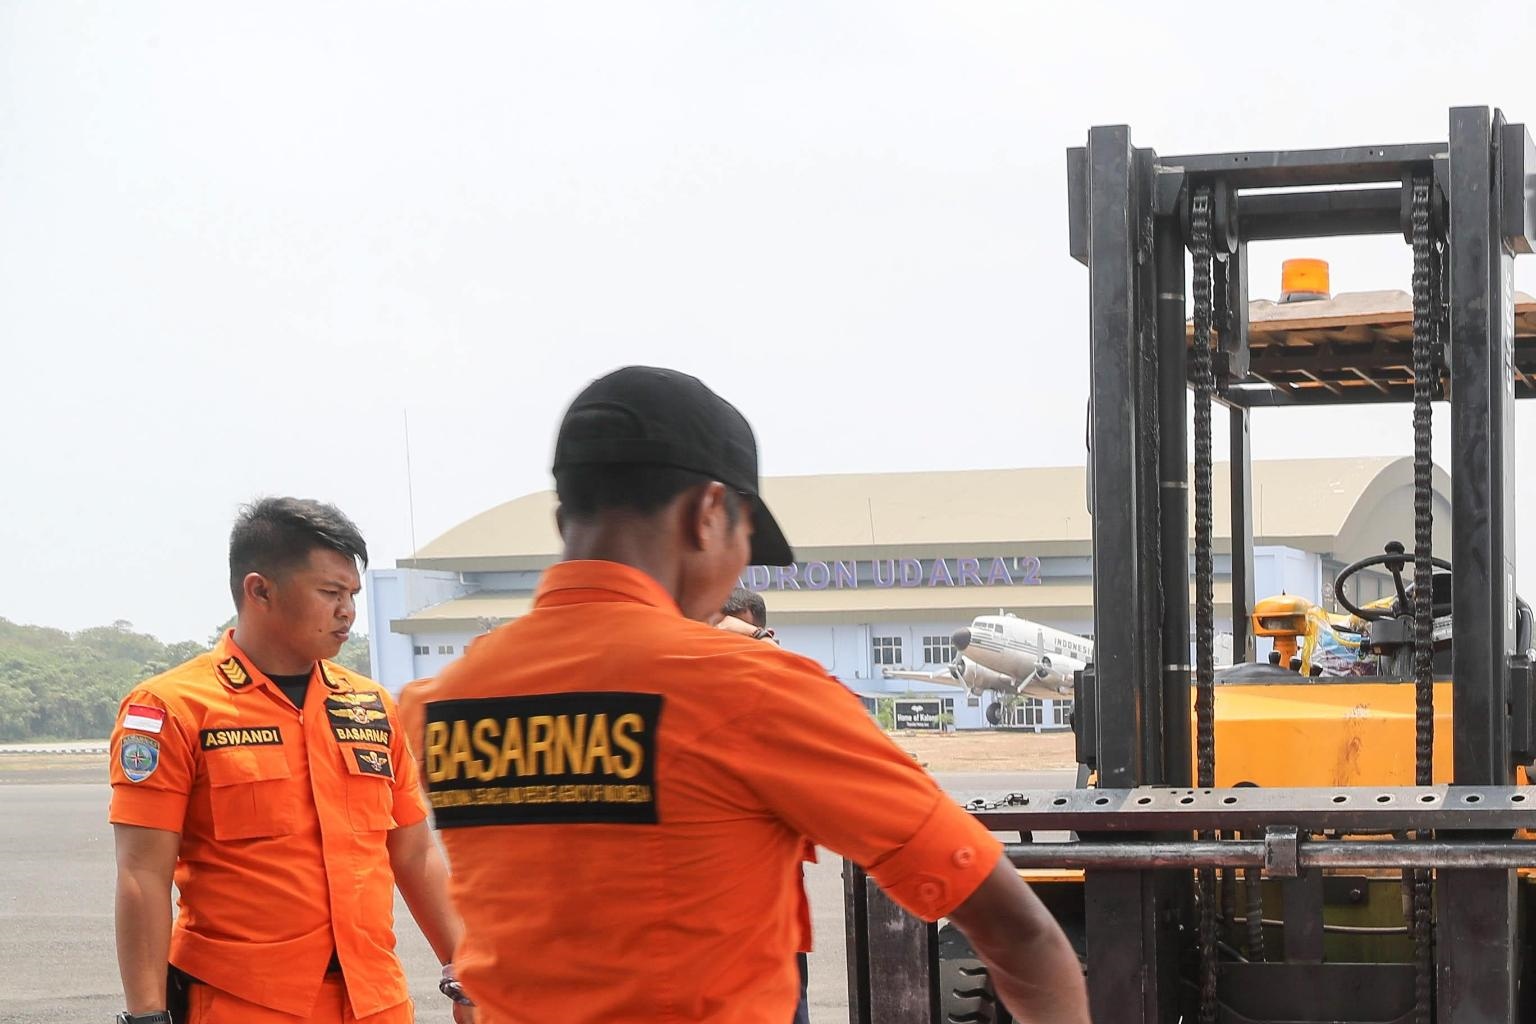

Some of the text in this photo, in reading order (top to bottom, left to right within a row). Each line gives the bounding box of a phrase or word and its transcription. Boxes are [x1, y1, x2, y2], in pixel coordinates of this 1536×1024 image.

[736, 556, 1042, 592] DRON UDARA 2
[1055, 637, 1093, 655] INDONESI
[205, 729, 280, 747] ASWANDI
[335, 727, 388, 745] BASARNAS
[426, 712, 645, 783] BASARNAS
